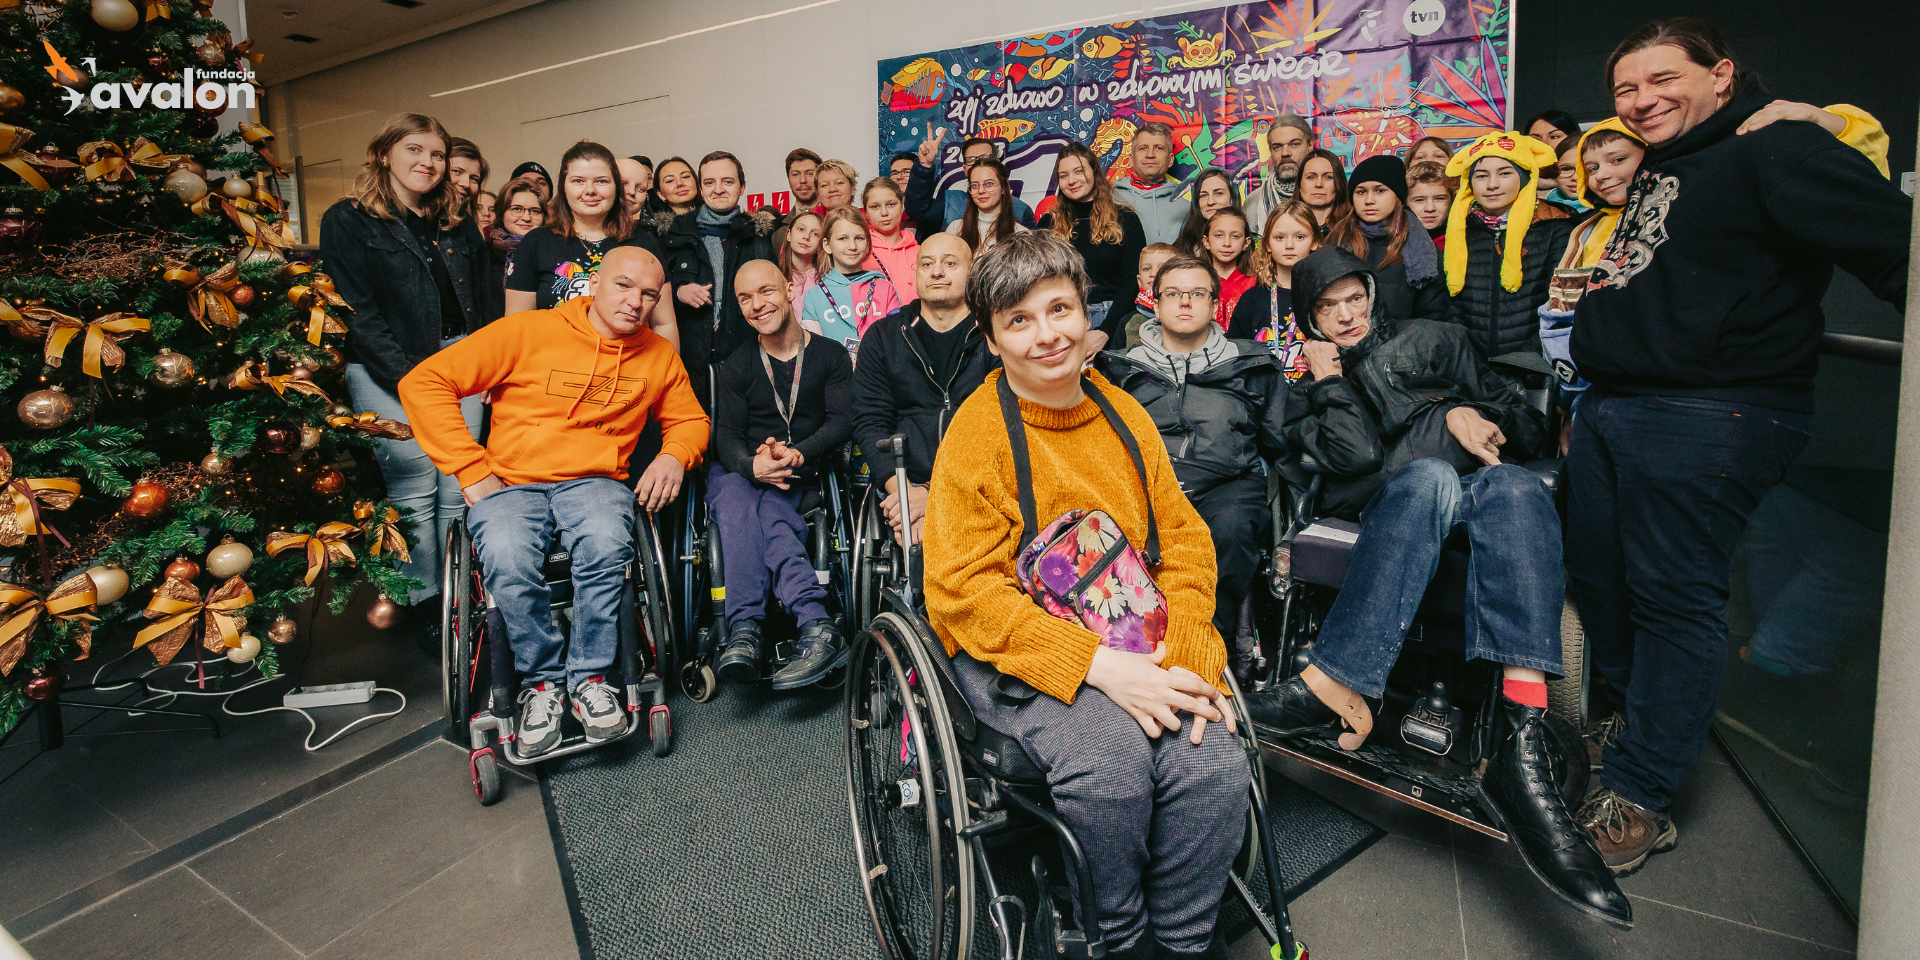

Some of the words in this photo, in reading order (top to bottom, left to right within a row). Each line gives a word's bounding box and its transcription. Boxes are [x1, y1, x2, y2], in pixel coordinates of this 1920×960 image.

[1410, 11, 1438, 23] tvn
[984, 79, 1064, 116] zdrowo
[1078, 83, 1099, 103] w
[1107, 58, 1222, 108] zdrowym
[823, 301, 882, 324] COOL
